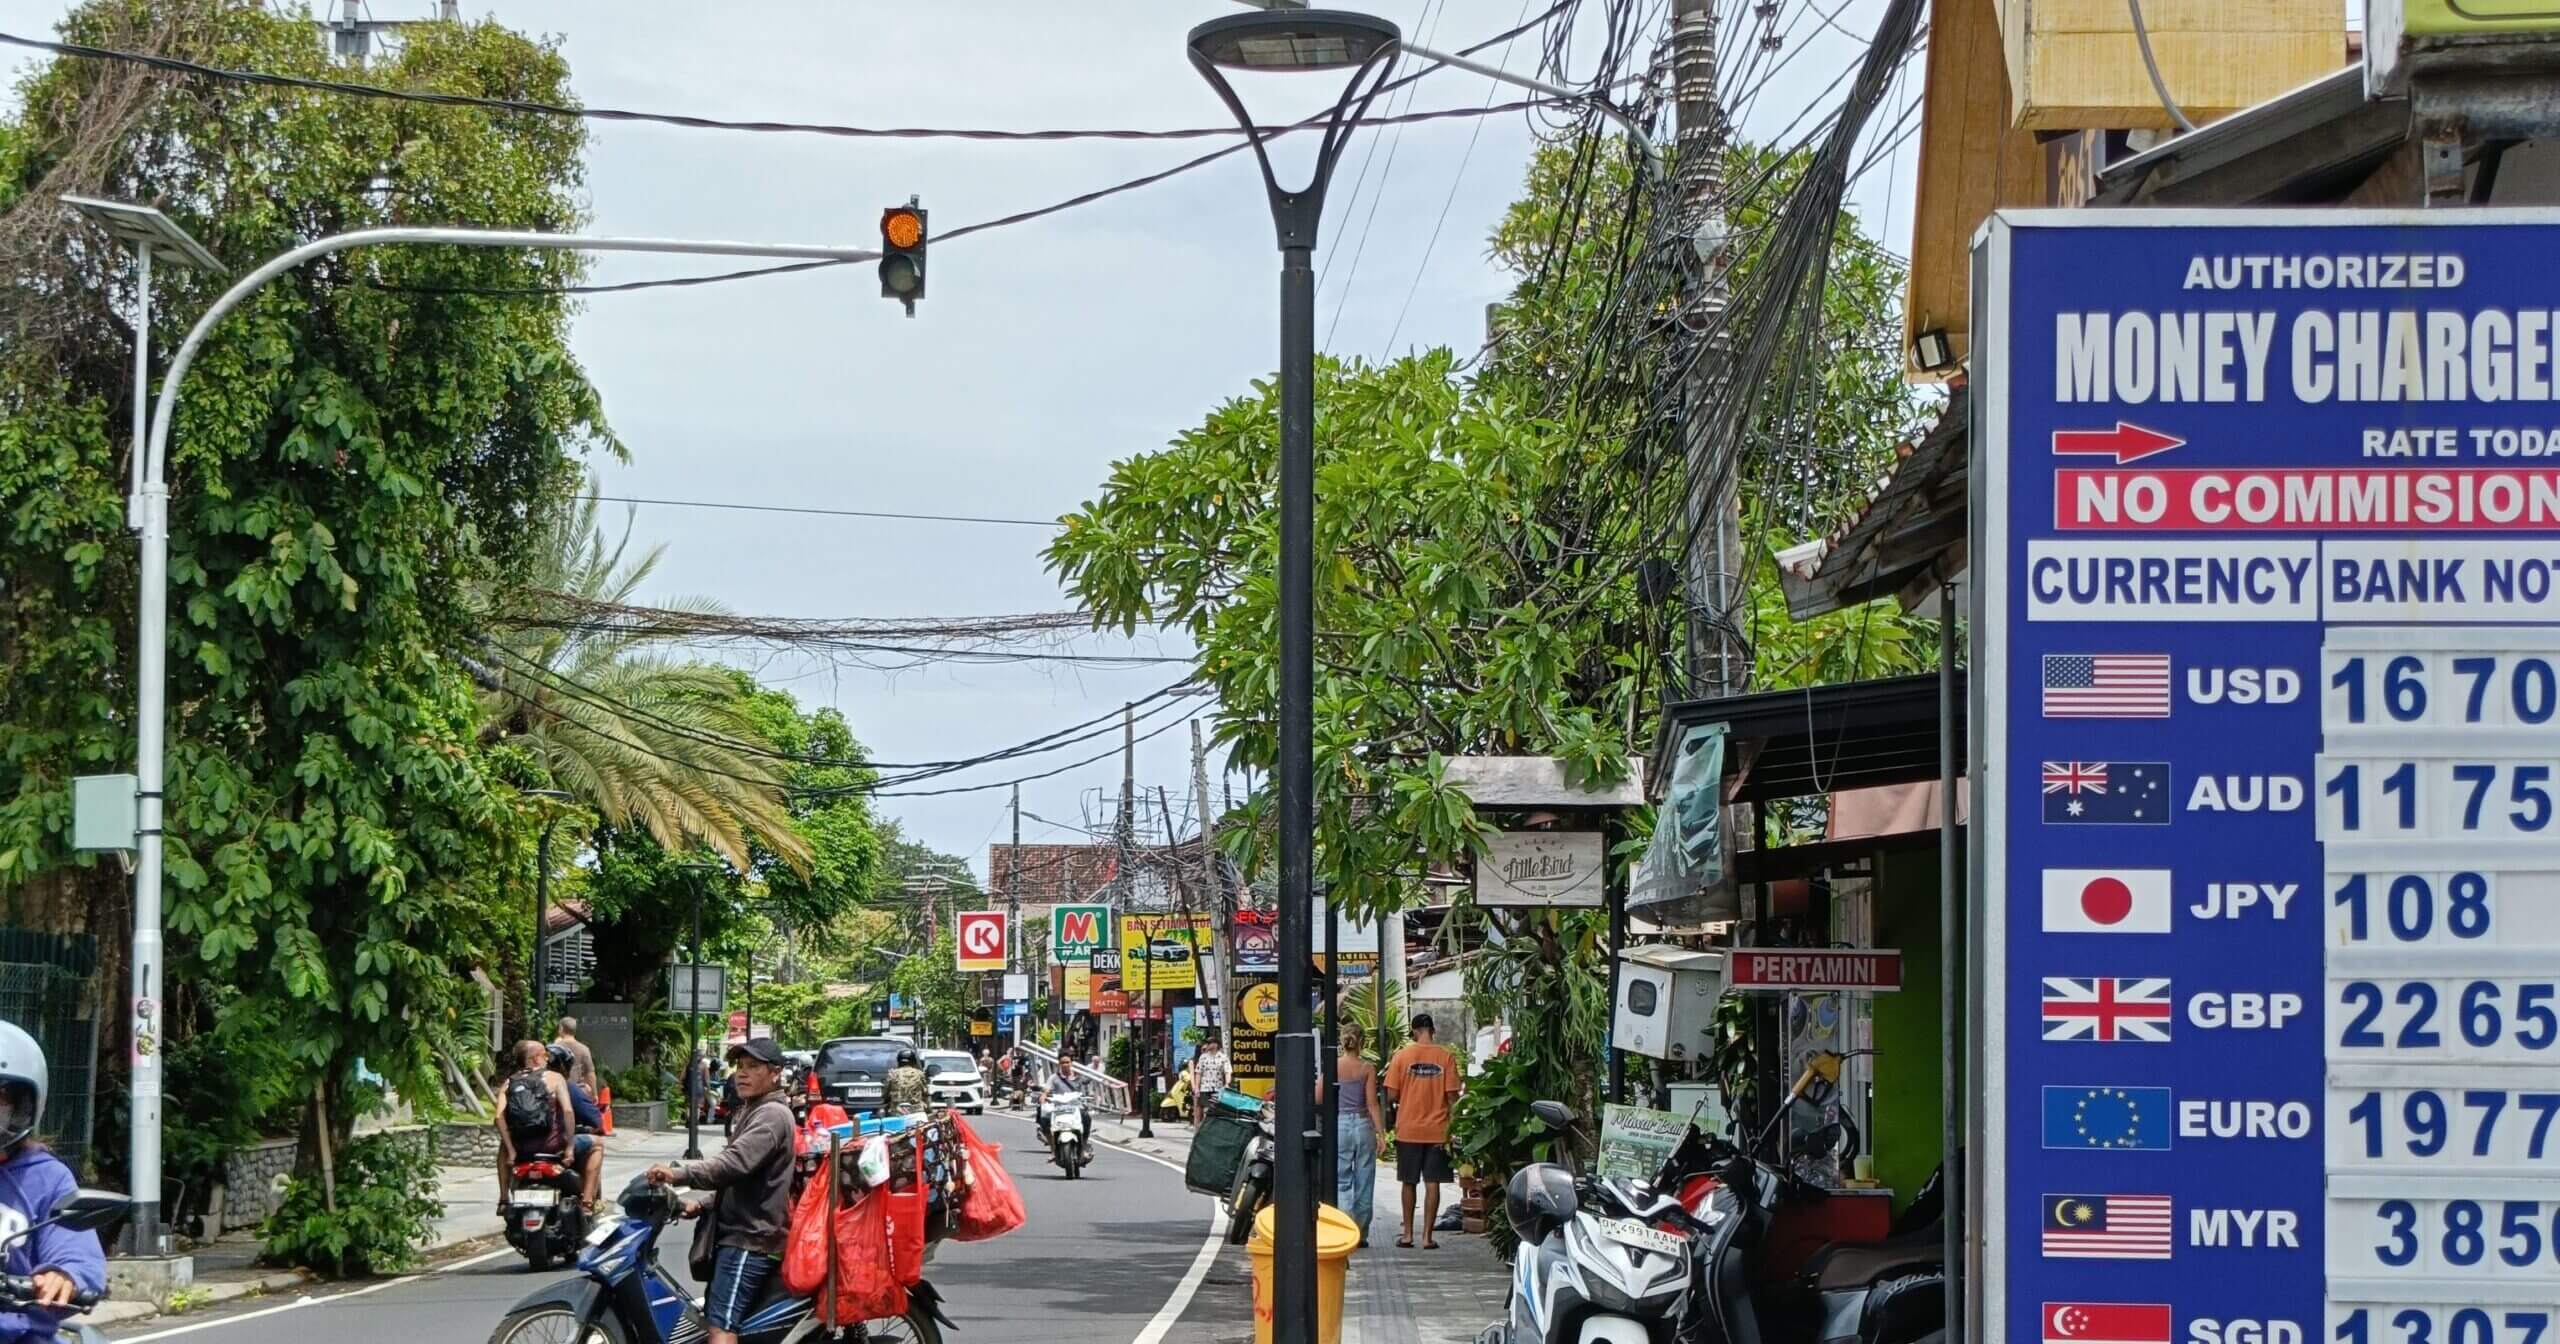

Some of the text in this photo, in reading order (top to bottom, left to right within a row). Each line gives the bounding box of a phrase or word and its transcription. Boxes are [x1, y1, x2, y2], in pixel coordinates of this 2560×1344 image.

[2183, 256, 2465, 289] AUTHORIZED
[2056, 310, 2560, 403] MONEY CHARGE
[2363, 430, 2457, 457] RATE
[2077, 474, 2560, 523] NO COMMISION
[2032, 557, 2560, 605] CURRENCY BANK NO
[2187, 669, 2300, 704] USD
[2187, 777, 2302, 812] AUD
[2191, 872, 2490, 941] JPY 108
[1752, 956, 1877, 983] PERTAMINI
[2187, 993, 2302, 1029] GBP
[1233, 1040, 1270, 1049] Garden
[1233, 1052, 1256, 1061] Pool
[2179, 1101, 2311, 1138] EURO
[2190, 1199, 2560, 1267] MYR 385
[2188, 1319, 2302, 1344] SGD
